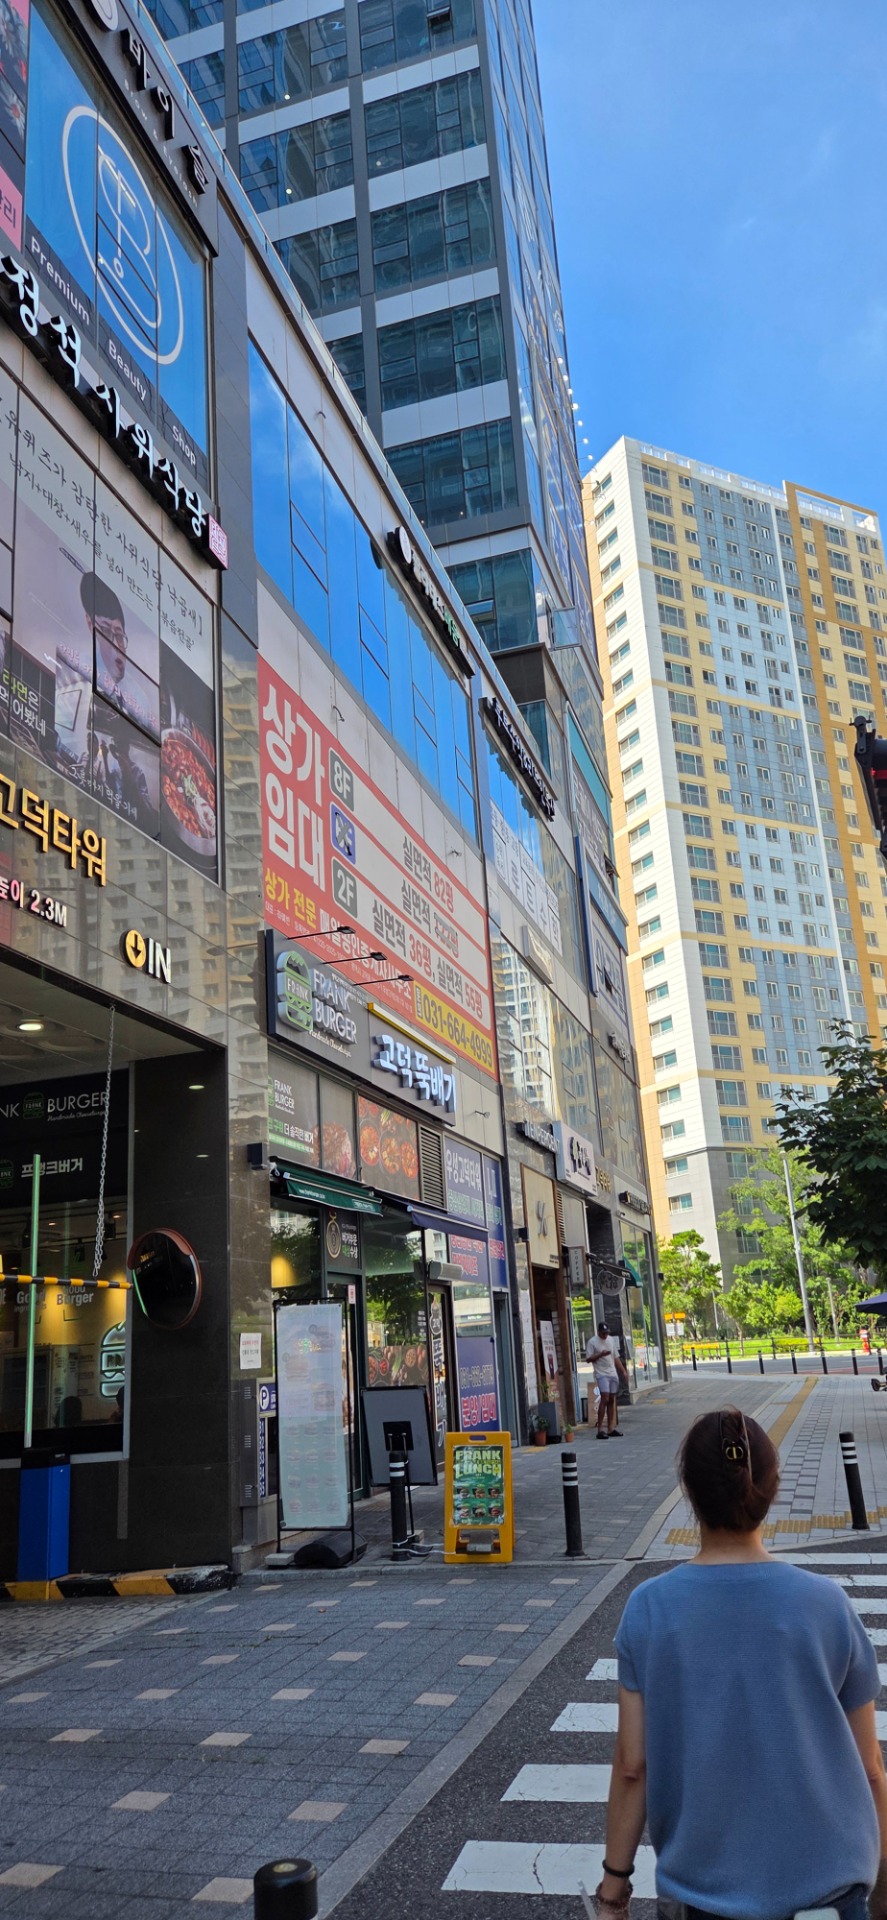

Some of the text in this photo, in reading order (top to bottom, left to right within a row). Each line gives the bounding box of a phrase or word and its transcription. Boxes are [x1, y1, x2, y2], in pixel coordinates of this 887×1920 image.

[31, 236, 198, 466] Premium Beauty Shop
[263, 683, 326, 807] 상가
[333, 760, 352, 802] 8F
[265, 772, 327, 894] 임대
[337, 868, 355, 908] 2F
[403, 836, 432, 892] 실면적
[434, 871, 455, 914] 82평
[30, 889, 68, 928] 2.3M
[265, 867, 290, 911] 상가
[293, 887, 317, 930] 전문
[402, 878, 432, 934] 실면적
[148, 937, 172, 983] IN
[372, 898, 407, 958] 실면적
[437, 956, 464, 1004] 실면적
[464, 982, 483, 1020] 55평
[313, 968, 351, 1014] FRANK
[314, 998, 358, 1044] BURGER
[422, 993, 493, 1068] 031-664-4999
[274, 1079, 292, 1096] FRANK
[378, 1034, 457, 1112] 고덕뚝배기
[47, 1091, 108, 1113] BURGER
[274, 1091, 295, 1110] BURGER
[57, 1292, 94, 1307] Burger
[461, 1392, 497, 1428] 분양/임대
[455, 1450, 501, 1461] FRANK
[455, 1463, 502, 1479] LUNCH
